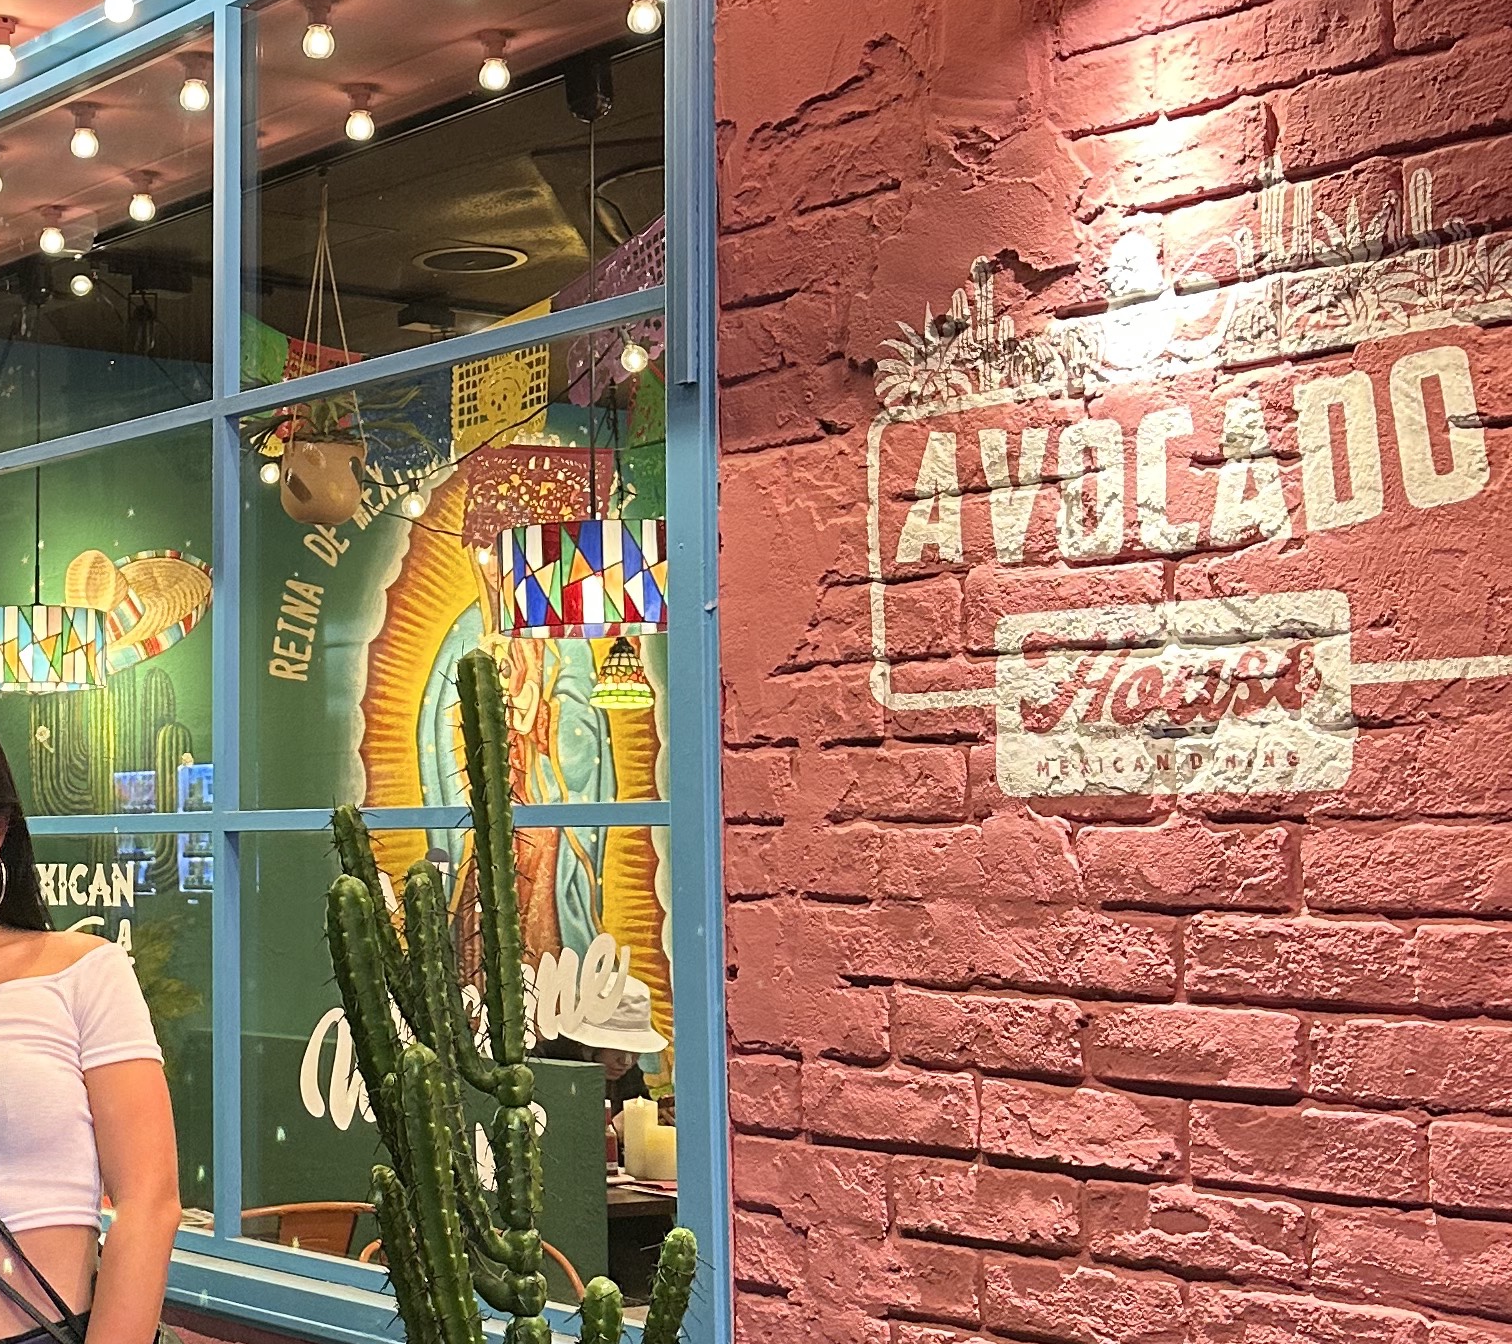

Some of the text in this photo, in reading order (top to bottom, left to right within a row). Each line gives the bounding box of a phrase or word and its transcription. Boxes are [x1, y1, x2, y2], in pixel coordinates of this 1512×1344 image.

[896, 345, 1491, 564] AVOCADO
[269, 579, 324, 682] REINA
[303, 524, 350, 568] DE
[1020, 632, 1323, 734] House
[1037, 750, 1301, 778] MEXICAN DNING
